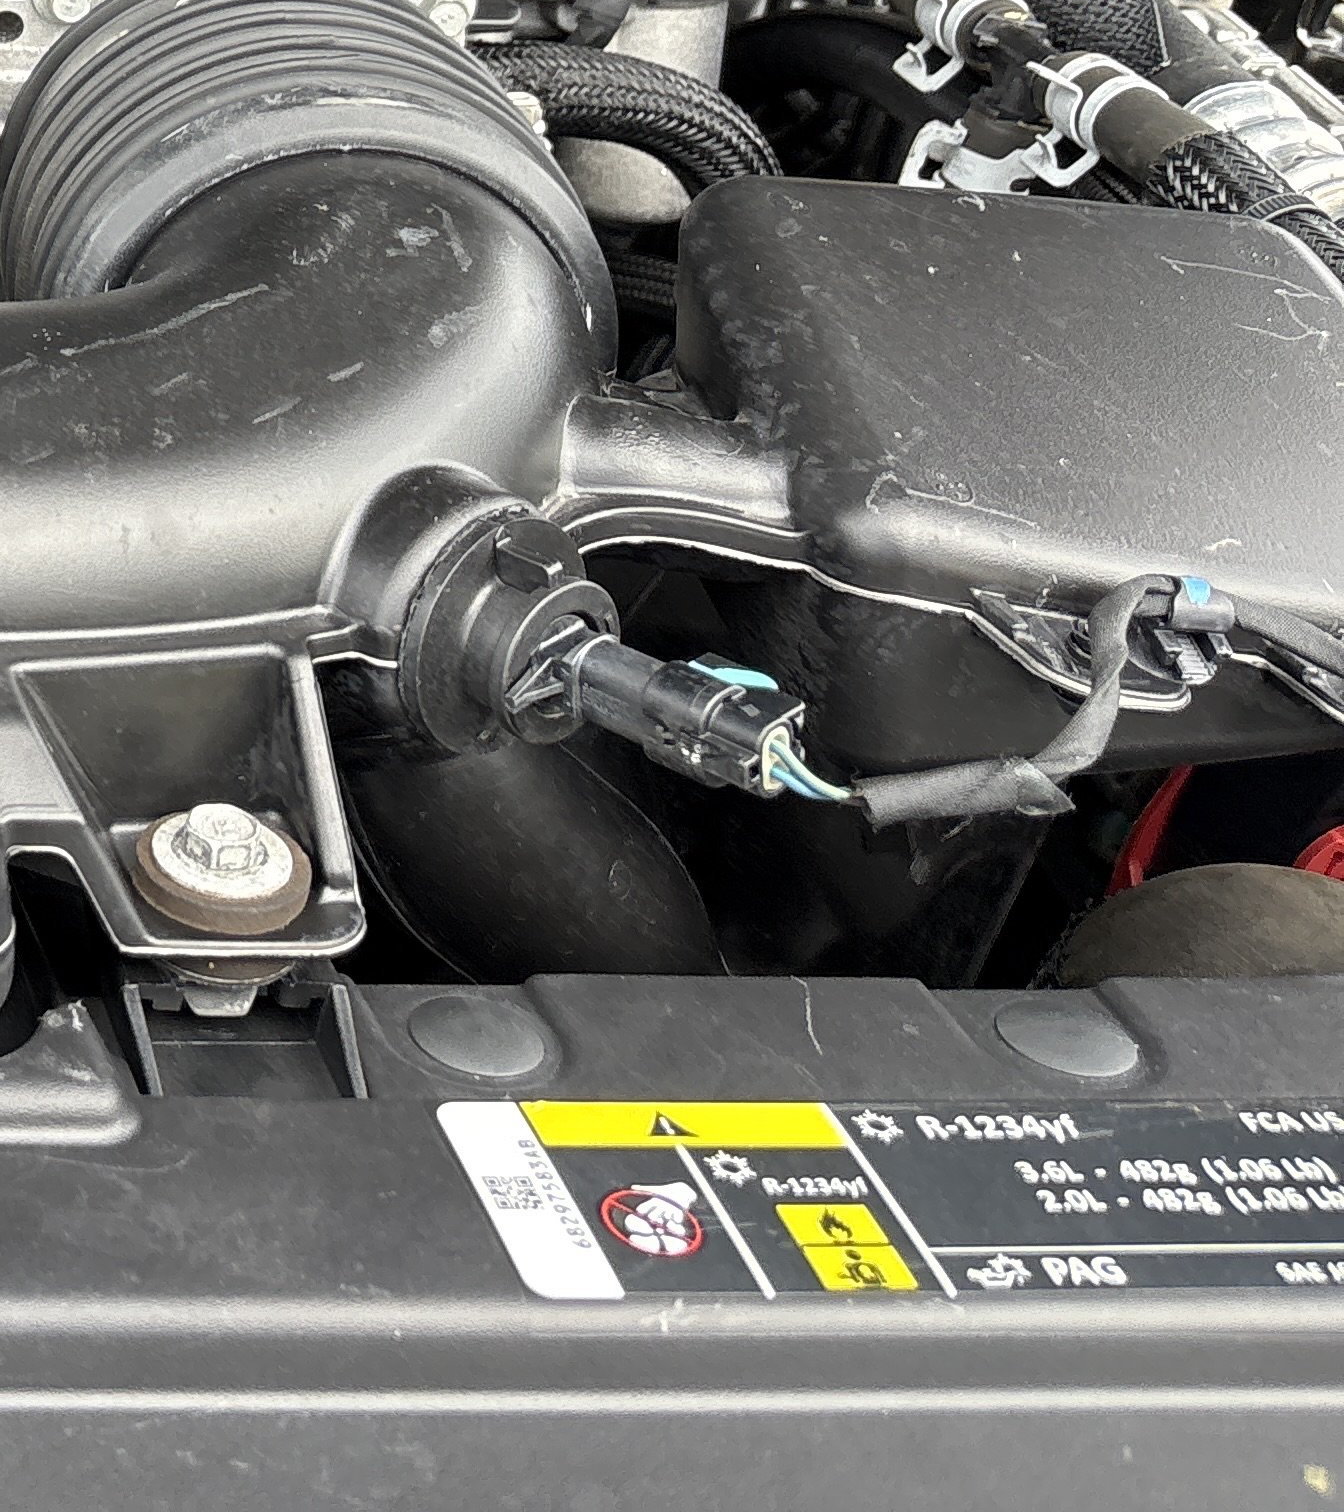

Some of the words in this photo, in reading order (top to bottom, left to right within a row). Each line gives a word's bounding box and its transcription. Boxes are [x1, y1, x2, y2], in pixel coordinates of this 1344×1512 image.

[915, 1113, 1080, 1143] R-1234yf
[1238, 1111, 1304, 1133] FCA
[1014, 1159, 1084, 1184] 3.6L
[1119, 1159, 1198, 1185] 482g
[1201, 1156, 1283, 1185] (1.06
[1280, 1155, 1338, 1184] Lb)
[517, 1139, 592, 1249] 68297583AB
[761, 1175, 870, 1199] R-1234yf
[1036, 1188, 1107, 1213] 2.0L
[1142, 1187, 1222, 1216] 482g
[1225, 1185, 1310, 1216] (1.06
[1040, 1256, 1129, 1286] PAG
[1275, 1261, 1328, 1284] SAE
